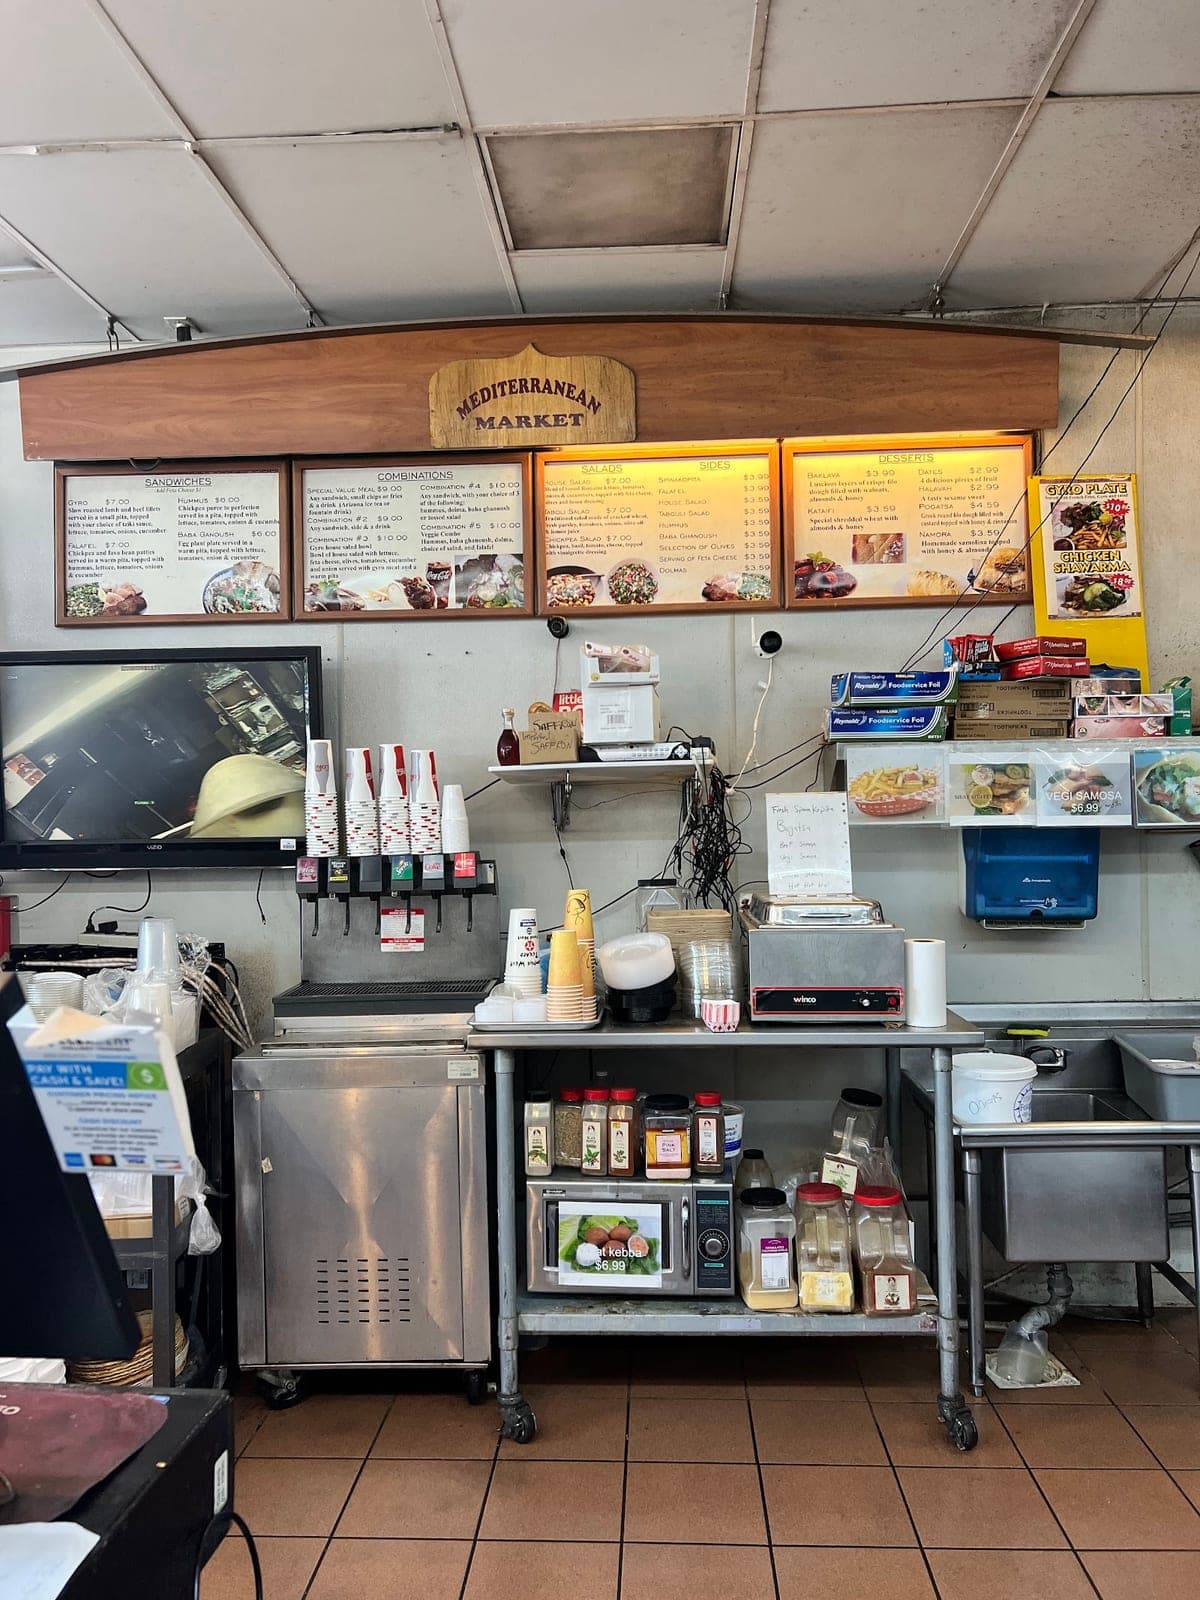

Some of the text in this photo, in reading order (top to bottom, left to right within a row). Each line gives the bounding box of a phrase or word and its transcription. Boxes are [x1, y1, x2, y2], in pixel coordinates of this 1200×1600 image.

[456, 377, 602, 420] MEDITERRANEAN
[475, 413, 584, 430] MARKET
[879, 454, 934, 463] DESSERTS
[582, 464, 622, 473] SALADS
[700, 461, 730, 470] SIDES
[378, 471, 454, 481] COMBINATIONS
[145, 478, 212, 487] SANDWICHES
[1046, 483, 1128, 496] GYRO PLATE
[1060, 551, 1121, 563] CHICKEN
[1054, 562, 1131, 574] SHAWARMA
[559, 693, 583, 705] little
[1046, 791, 1122, 801] VEGI SAMOSA
[1071, 803, 1099, 814] $6.99
[27, 1064, 92, 1074] PAY WITH
[31, 1076, 70, 1085] CASH
[609, 1247, 642, 1257] kebba
[596, 1261, 625, 1271] $6.99
